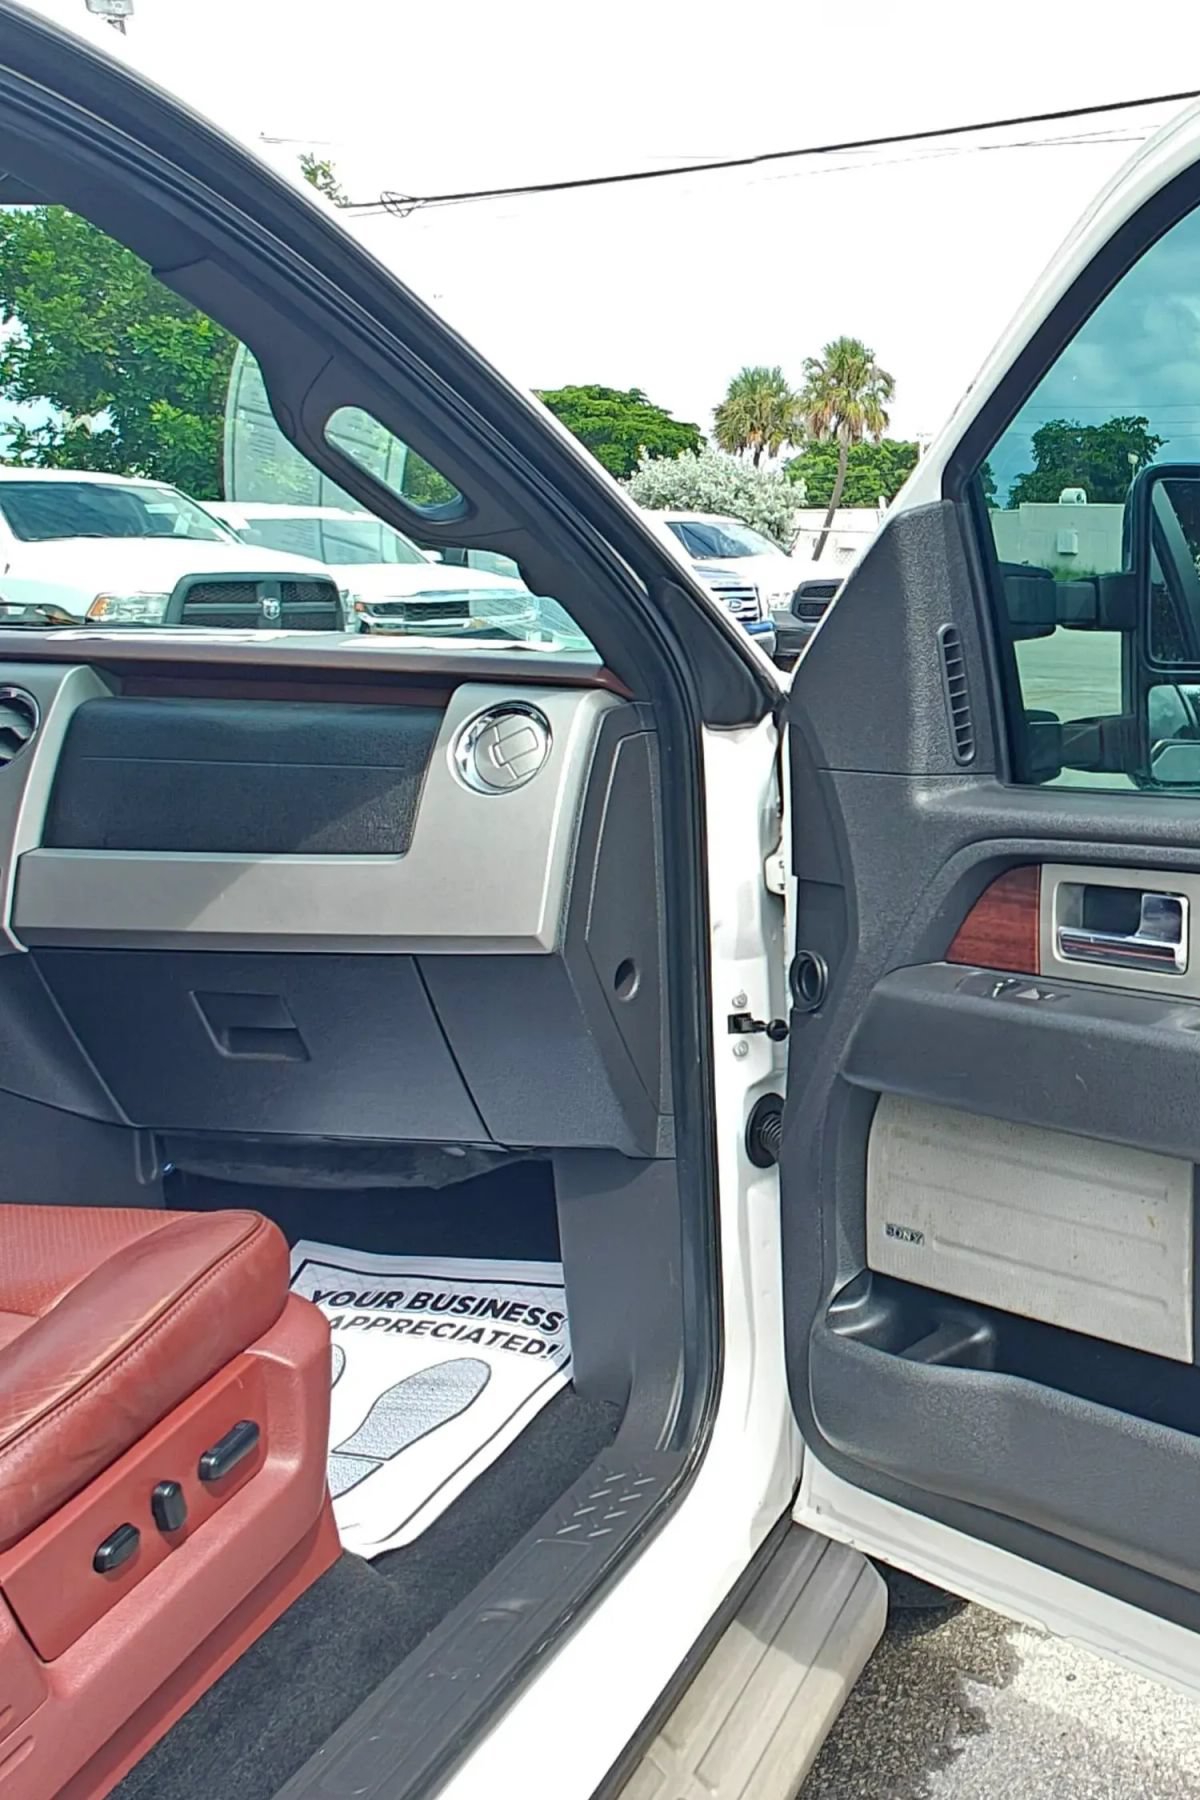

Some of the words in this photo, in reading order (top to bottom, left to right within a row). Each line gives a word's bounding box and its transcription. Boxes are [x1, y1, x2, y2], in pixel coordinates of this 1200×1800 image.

[885, 1222, 925, 1247] SONY
[312, 1290, 405, 1309] YOUR
[405, 1292, 566, 1332] BUSINESS
[329, 1314, 560, 1359] APPRECIATED!
